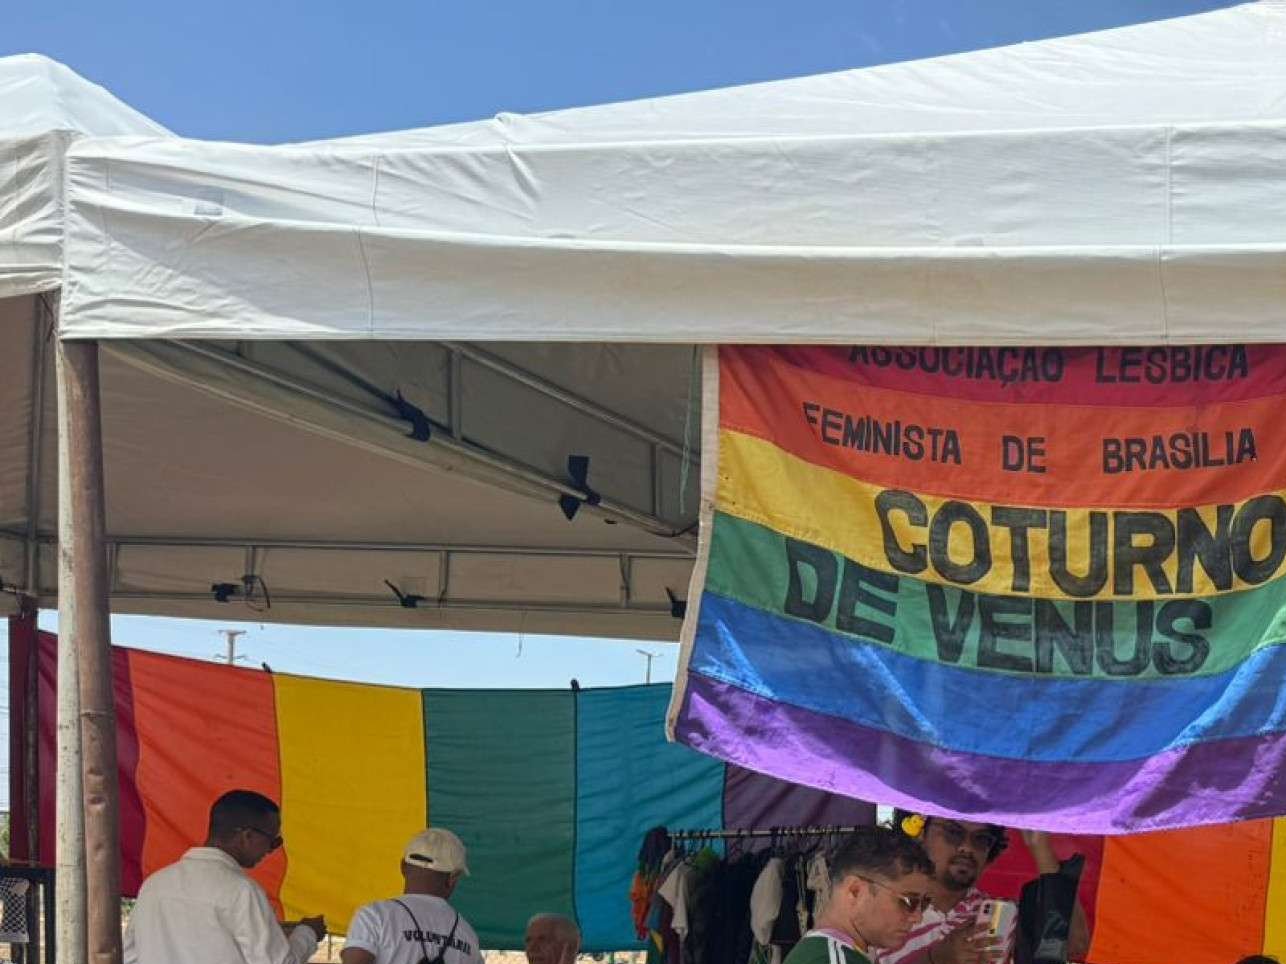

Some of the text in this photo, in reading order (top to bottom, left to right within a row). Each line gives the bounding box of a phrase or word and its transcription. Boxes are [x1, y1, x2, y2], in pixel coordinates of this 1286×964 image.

[803, 403, 1257, 475] FEMINISTA DE BRASILIA
[783, 534, 1213, 677] DE VENUS
